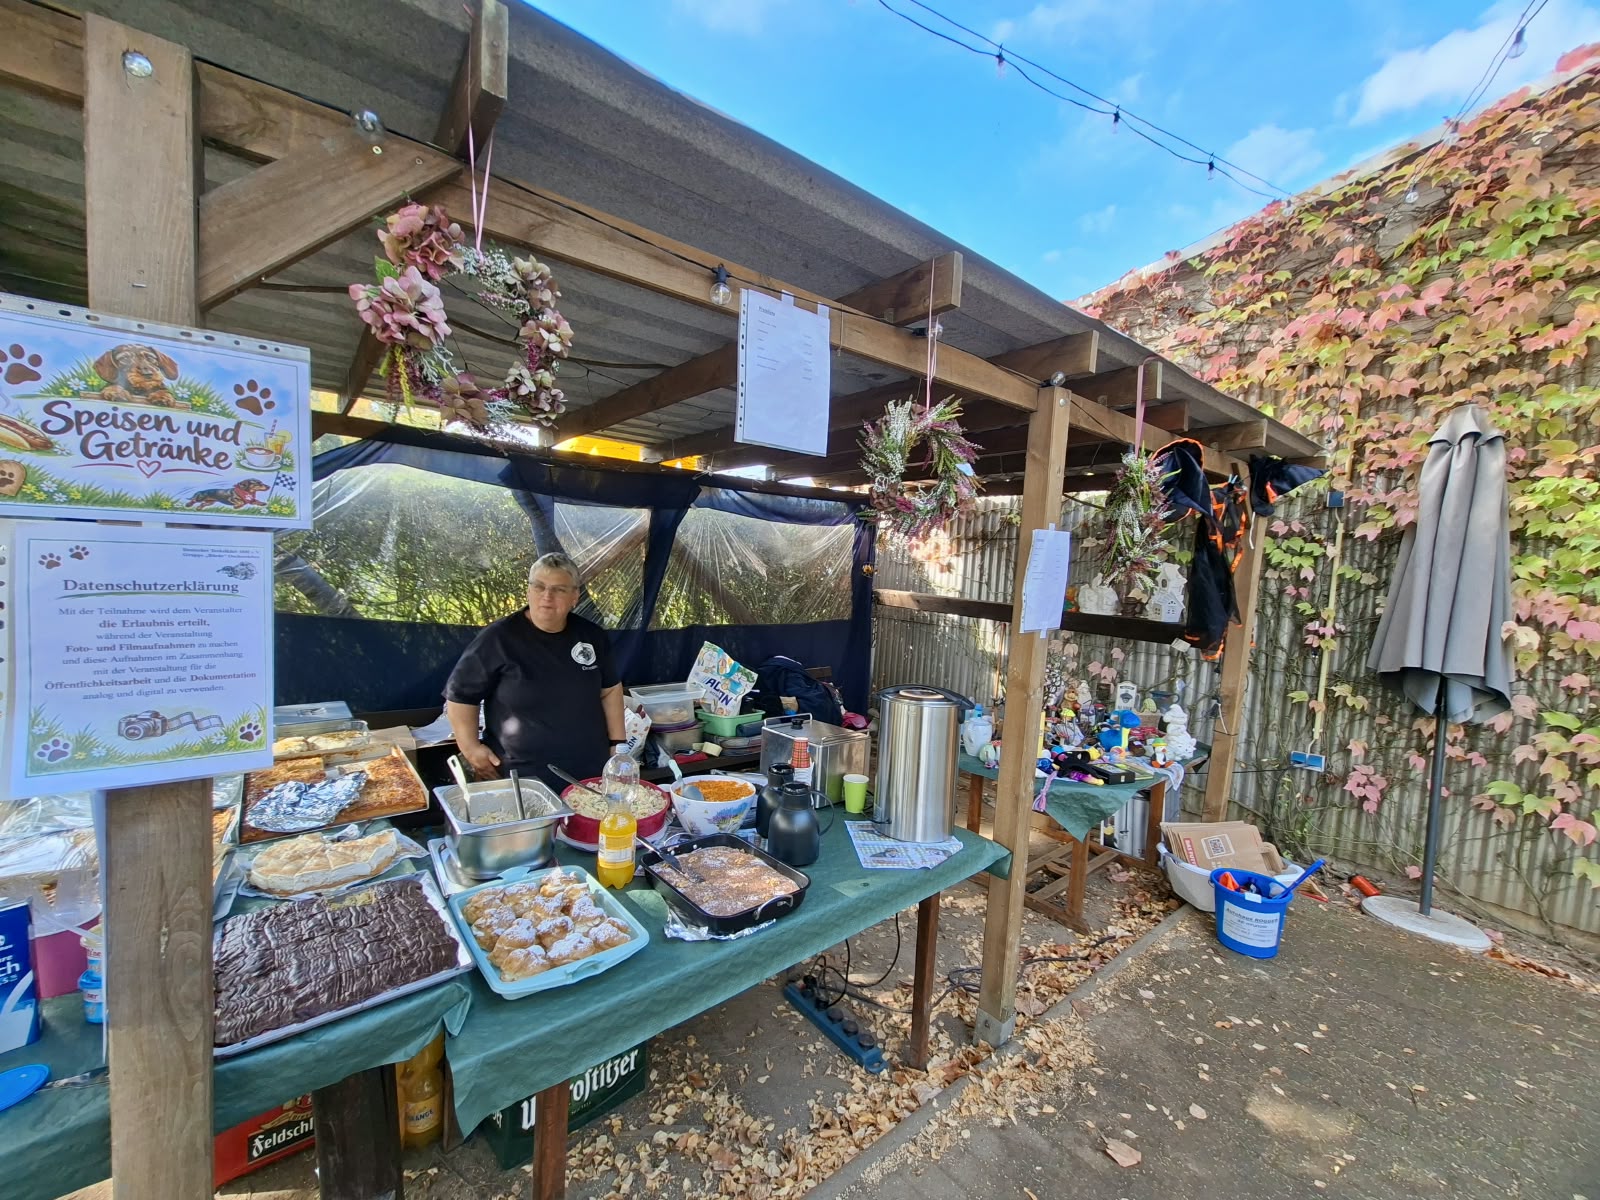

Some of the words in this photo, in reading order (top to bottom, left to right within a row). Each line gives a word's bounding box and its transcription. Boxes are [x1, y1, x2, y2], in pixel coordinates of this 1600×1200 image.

[41, 400, 180, 436] Speisen
[187, 420, 243, 446] und
[80, 430, 232, 470] Getränke
[63, 579, 239, 593] Datenschutzerklärung
[97, 607, 146, 615] Teilnahme
[99, 620, 117, 628] die
[122, 619, 174, 628] Erlaubnis
[177, 619, 210, 627] erteilt,
[96, 632, 136, 640] während
[65, 645, 93, 653] Foto-
[119, 642, 195, 651] Filmaufnahmen
[62, 657, 80, 665] und
[179, 651, 243, 659] Zusammenhang
[129, 664, 187, 673] Veranstaltung
[190, 663, 202, 671] für
[44, 677, 151, 690] Öffentlichkeitsarbeit
[154, 676, 171, 684] und
[190, 672, 256, 682] Dokumentation
[82, 691, 114, 700] analog
[136, 688, 164, 697] digital
[179, 685, 224, 693] verwenden
[252, 1117, 315, 1158] Feldschl
